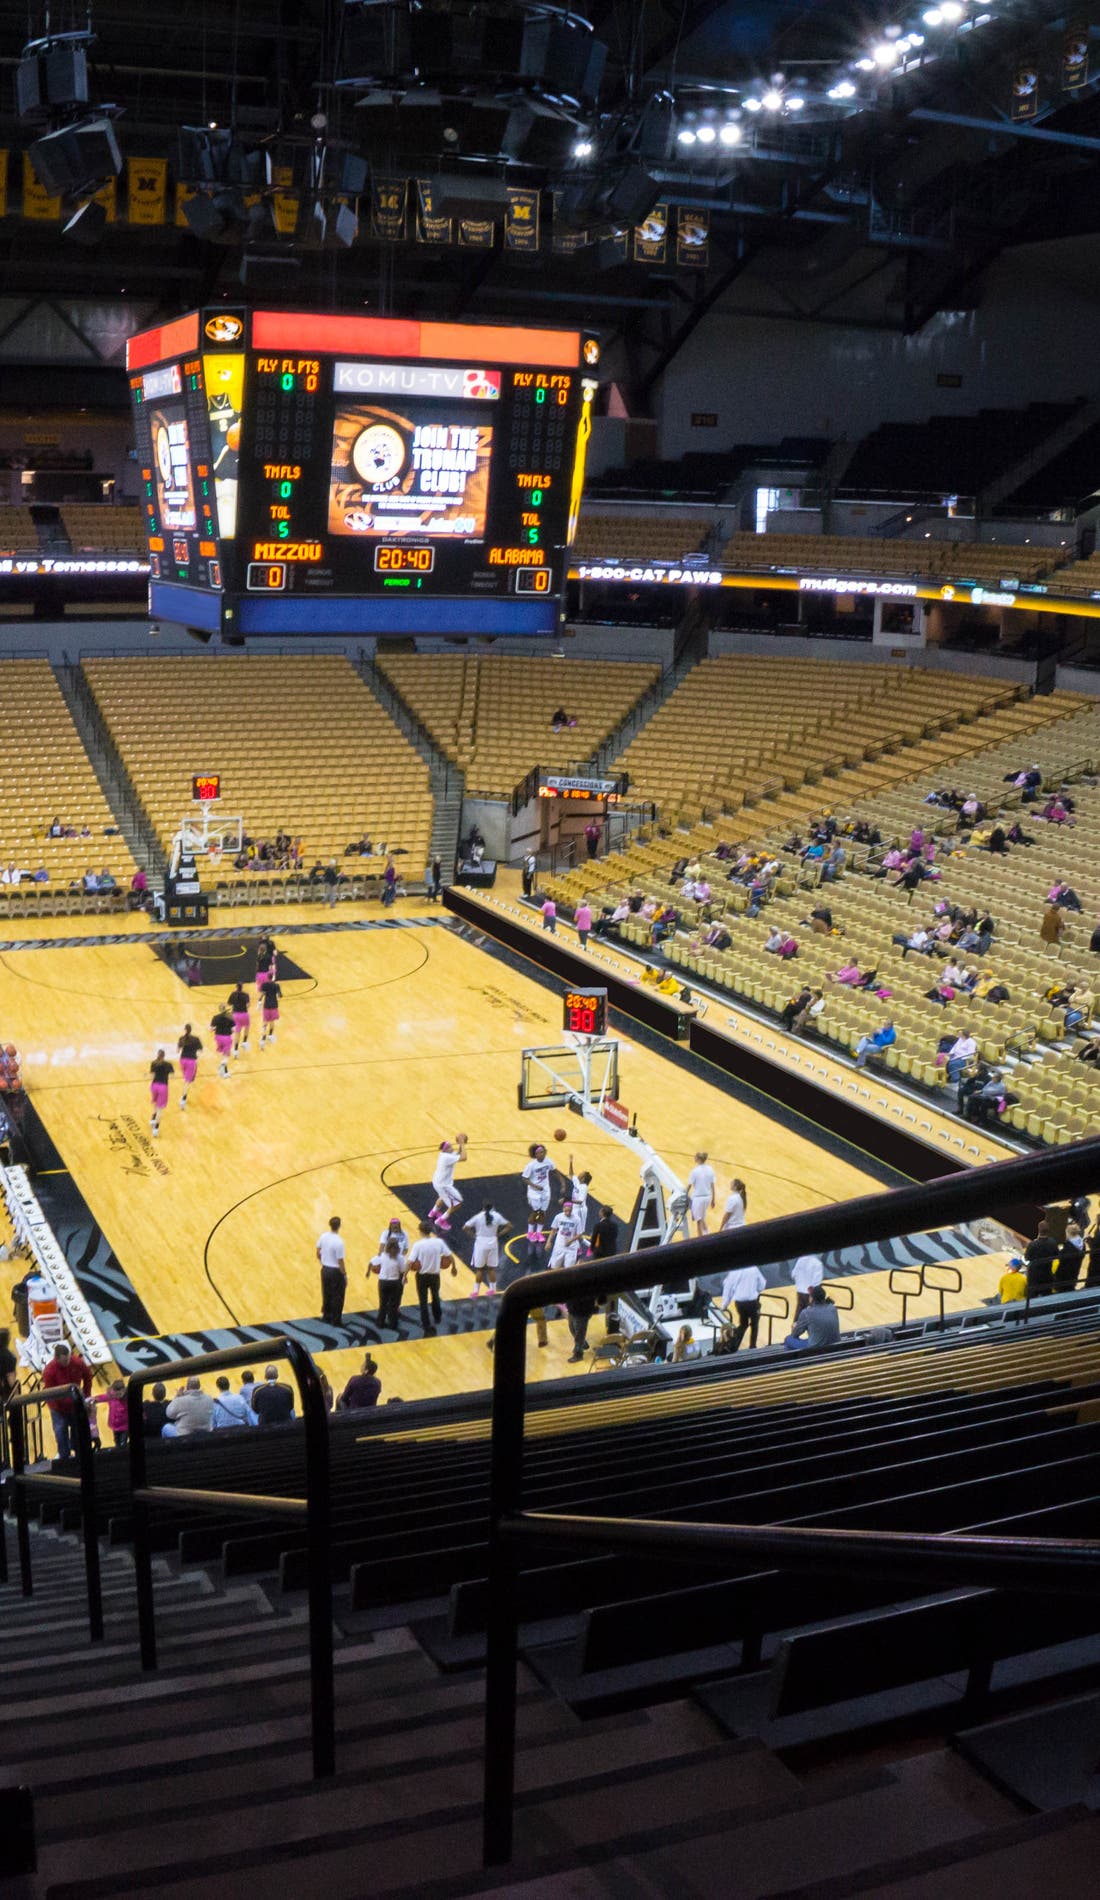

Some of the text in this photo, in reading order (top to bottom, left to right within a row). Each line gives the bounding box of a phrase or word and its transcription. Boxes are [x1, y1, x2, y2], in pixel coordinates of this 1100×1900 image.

[257, 358, 320, 375] PLY FL PTS
[282, 372, 318, 392] 0 0
[339, 369, 459, 390] KOMU-TV
[513, 372, 571, 389] PLY FL PTS
[535, 388, 567, 405] 0 0
[413, 425, 448, 448] JOIN
[449, 427, 480, 450] THE
[412, 448, 478, 472] TRUMAN
[281, 481, 292, 498] 0
[371, 476, 401, 493] CLUB
[419, 470, 467, 493] CLUB!
[531, 490, 543, 506] 0
[270, 505, 292, 519] TOL
[522, 512, 541, 526] TOL
[278, 521, 289, 538] 5
[528, 527, 539, 544] 5
[254, 543, 322, 561] MIZZOU
[379, 548, 431, 569] 20:40
[489, 547, 545, 565] ALABAMA
[268, 566, 282, 587] 0
[535, 571, 548, 591] 0
[578, 566, 723, 585] 1-800-CAT PAWS
[200, 786, 216, 800] 30
[566, 993, 598, 1012] 20:40
[569, 1008, 595, 1033] 30
